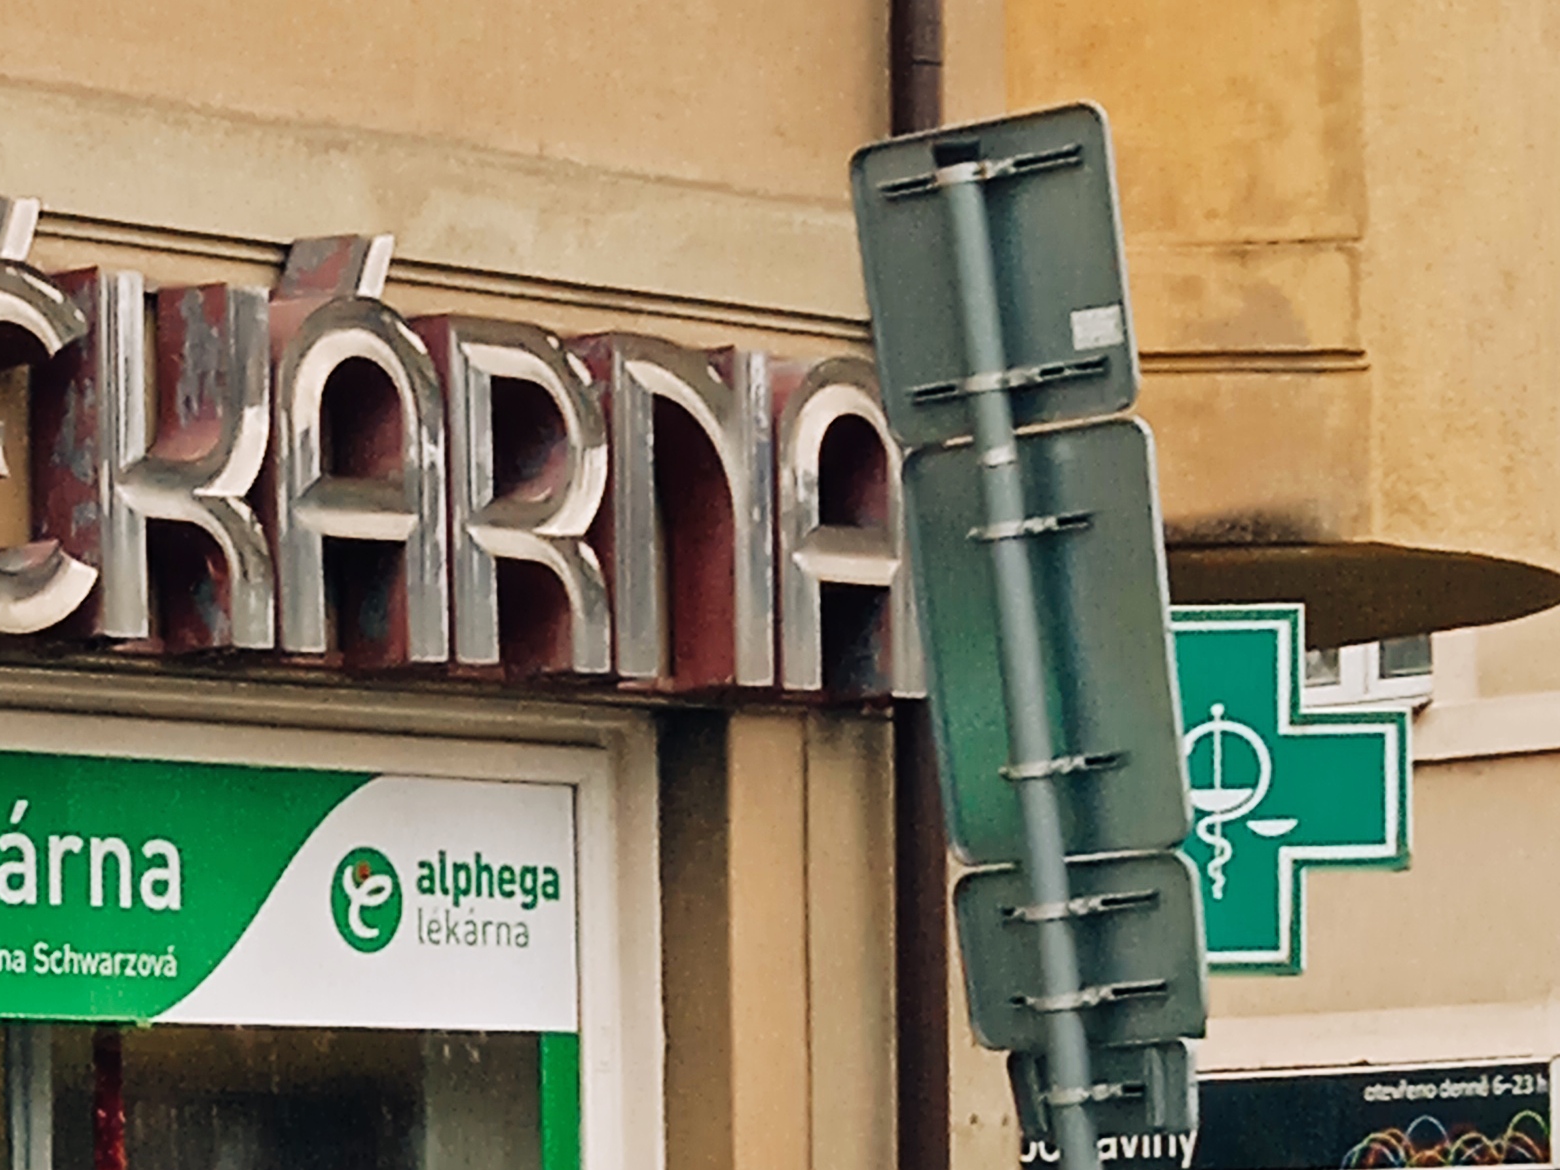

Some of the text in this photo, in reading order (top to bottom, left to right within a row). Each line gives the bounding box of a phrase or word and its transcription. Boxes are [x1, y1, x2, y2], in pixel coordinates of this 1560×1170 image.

[416, 849, 560, 910] alphega
[417, 906, 530, 948] lékárna
[33, 941, 178, 978] Schwarzová
